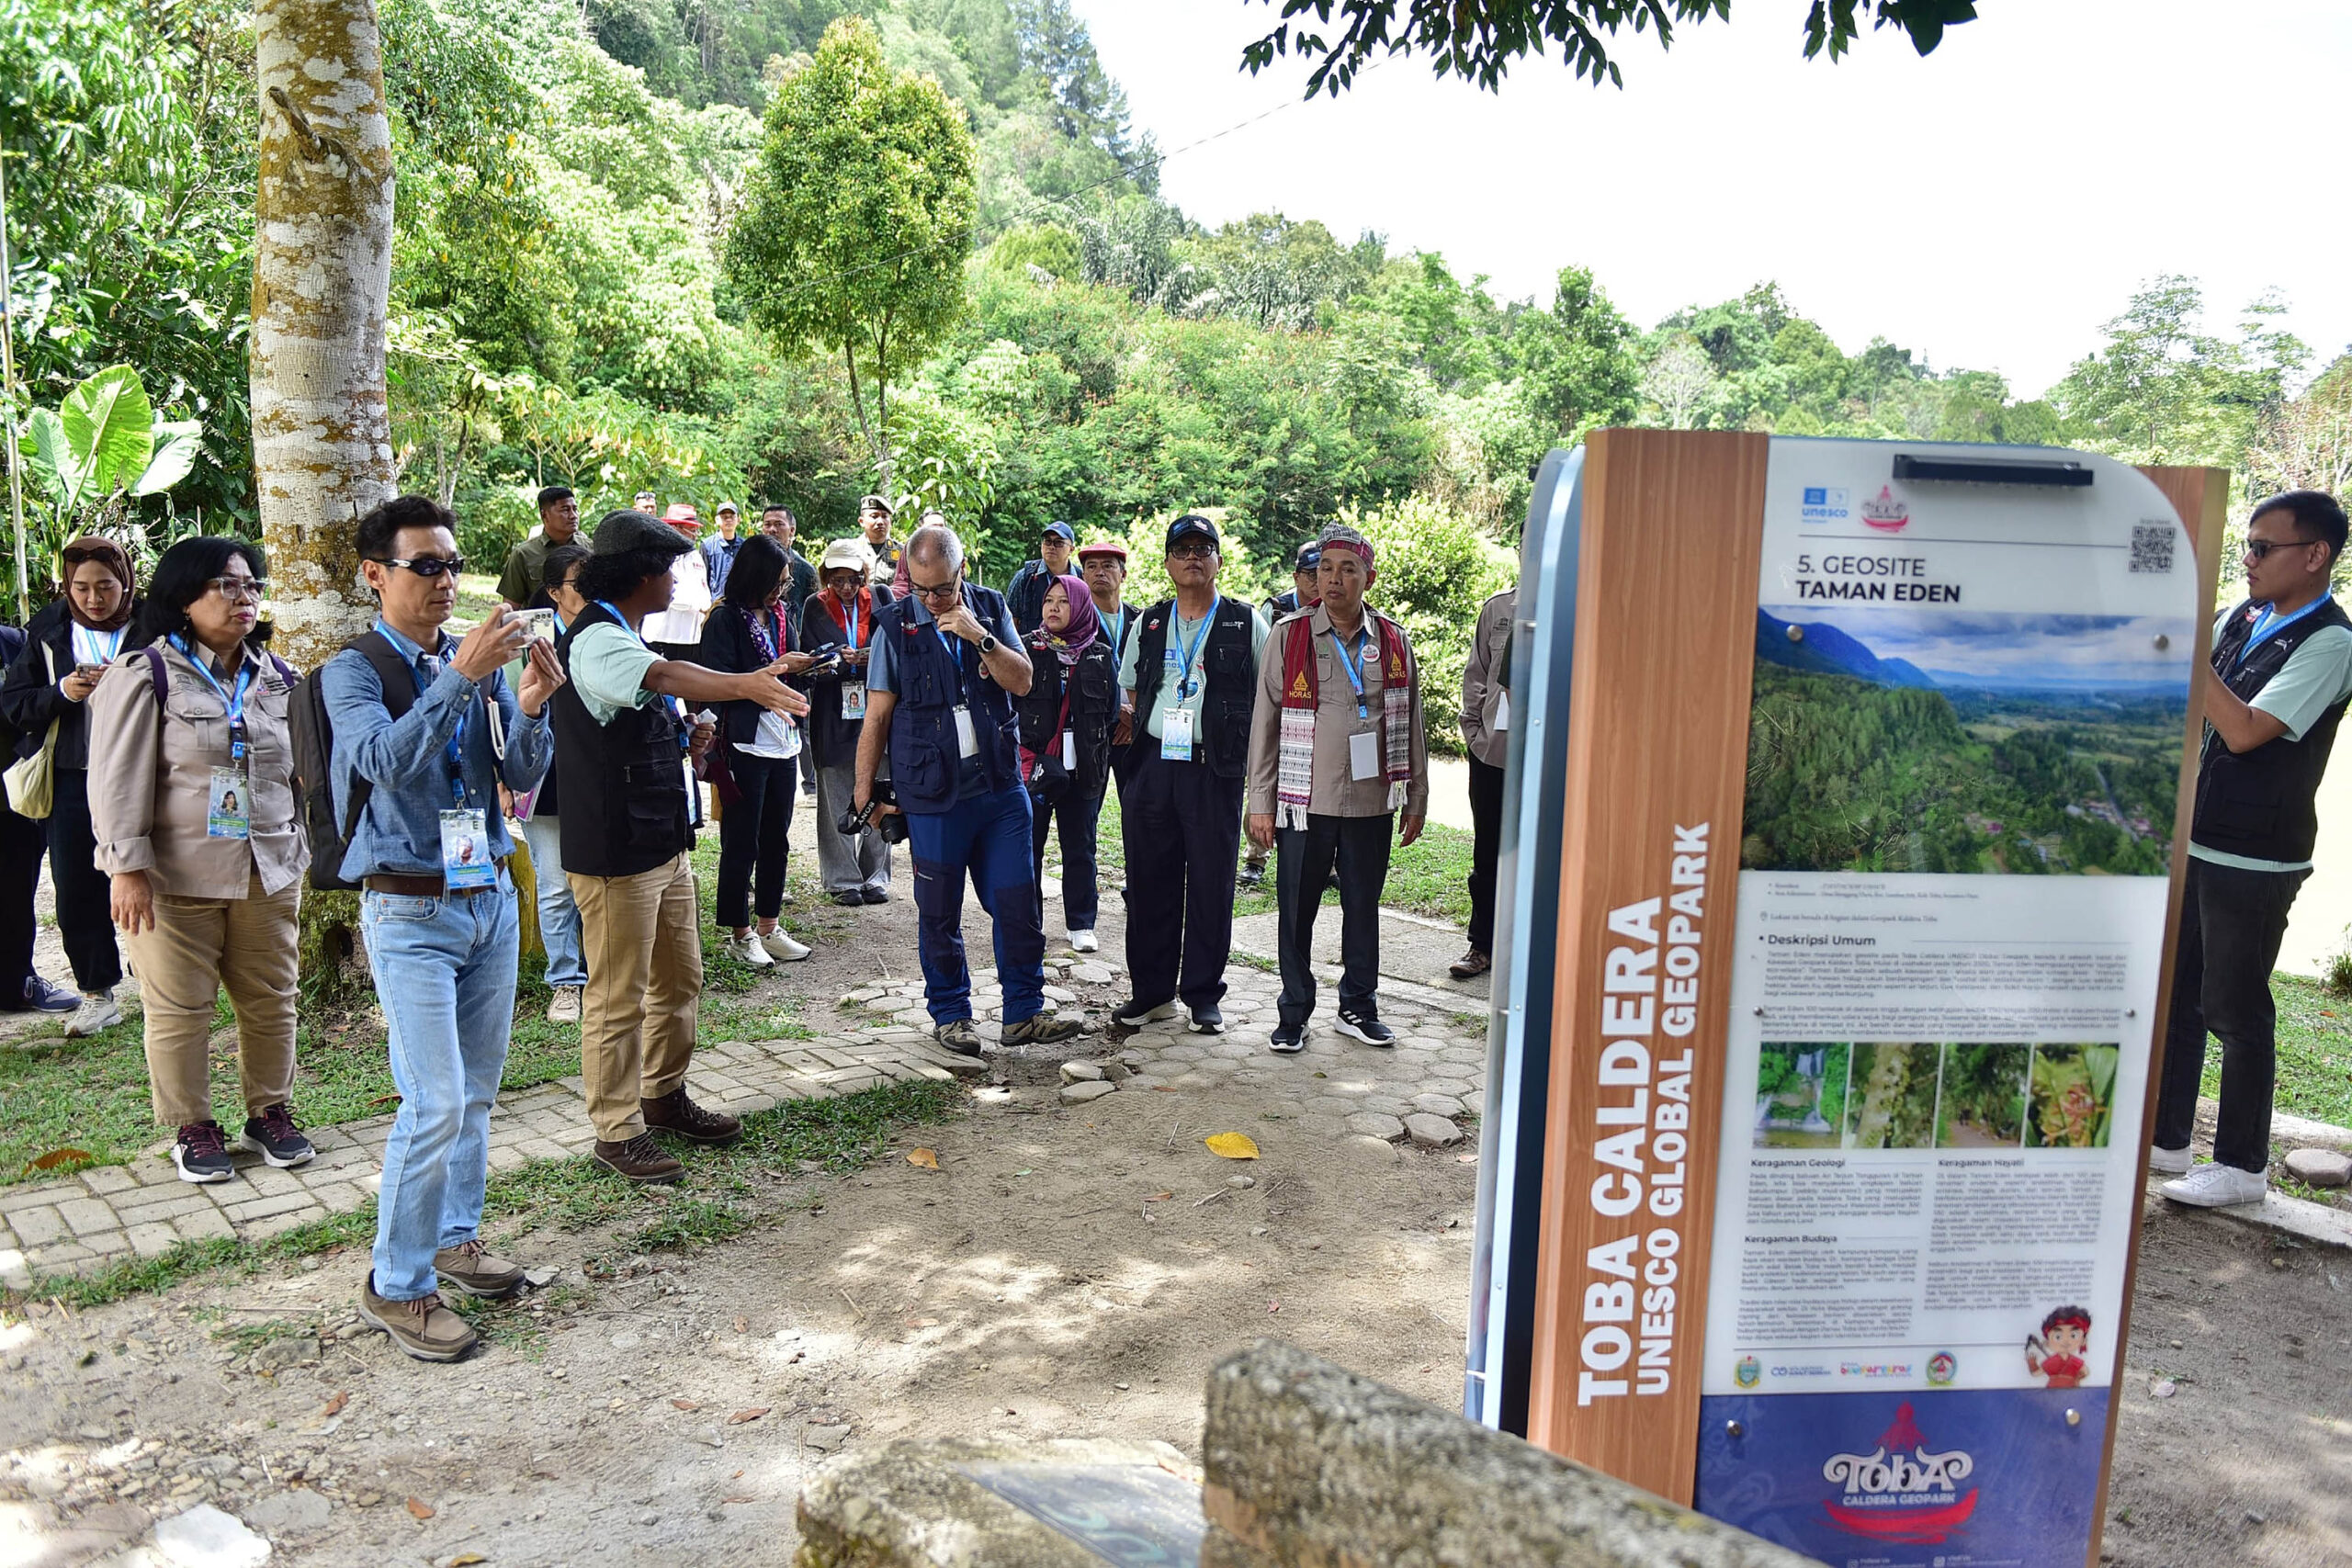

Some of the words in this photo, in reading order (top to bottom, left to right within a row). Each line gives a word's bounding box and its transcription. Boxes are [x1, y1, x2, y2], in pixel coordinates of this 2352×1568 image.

[1802, 508, 1849, 518] unesco
[1797, 555, 1815, 573] 5.
[1823, 556, 1926, 577] GEOSITE
[1796, 581, 1886, 600] TAMAN
[1894, 583, 1960, 603] EDEN
[1388, 671, 1407, 680] HORAS
[1289, 691, 1312, 699] HORAS
[858, 801, 875, 826] SONY
[1664, 823, 1708, 1003] GEOPARK
[1769, 933, 1828, 947] Deskripsi
[1832, 935, 1876, 945] Umum
[1591, 897, 1661, 1216] CALDERA
[1649, 1049, 1692, 1216] GLOBAL
[1751, 1159, 1806, 1168] Keragaman
[1809, 1158, 1845, 1168] Geologi
[1938, 1159, 1992, 1168] Keragaman
[1995, 1158, 2024, 1168] Hayati
[1745, 1235, 1800, 1245] Keragaman
[1802, 1235, 1838, 1244] Budaya
[1577, 1235, 1638, 1405] TOBA
[1636, 1228, 1679, 1394] UNESCO
[1843, 1494, 1896, 1506] CALDERA
[1899, 1493, 1955, 1505] GEOPARK
